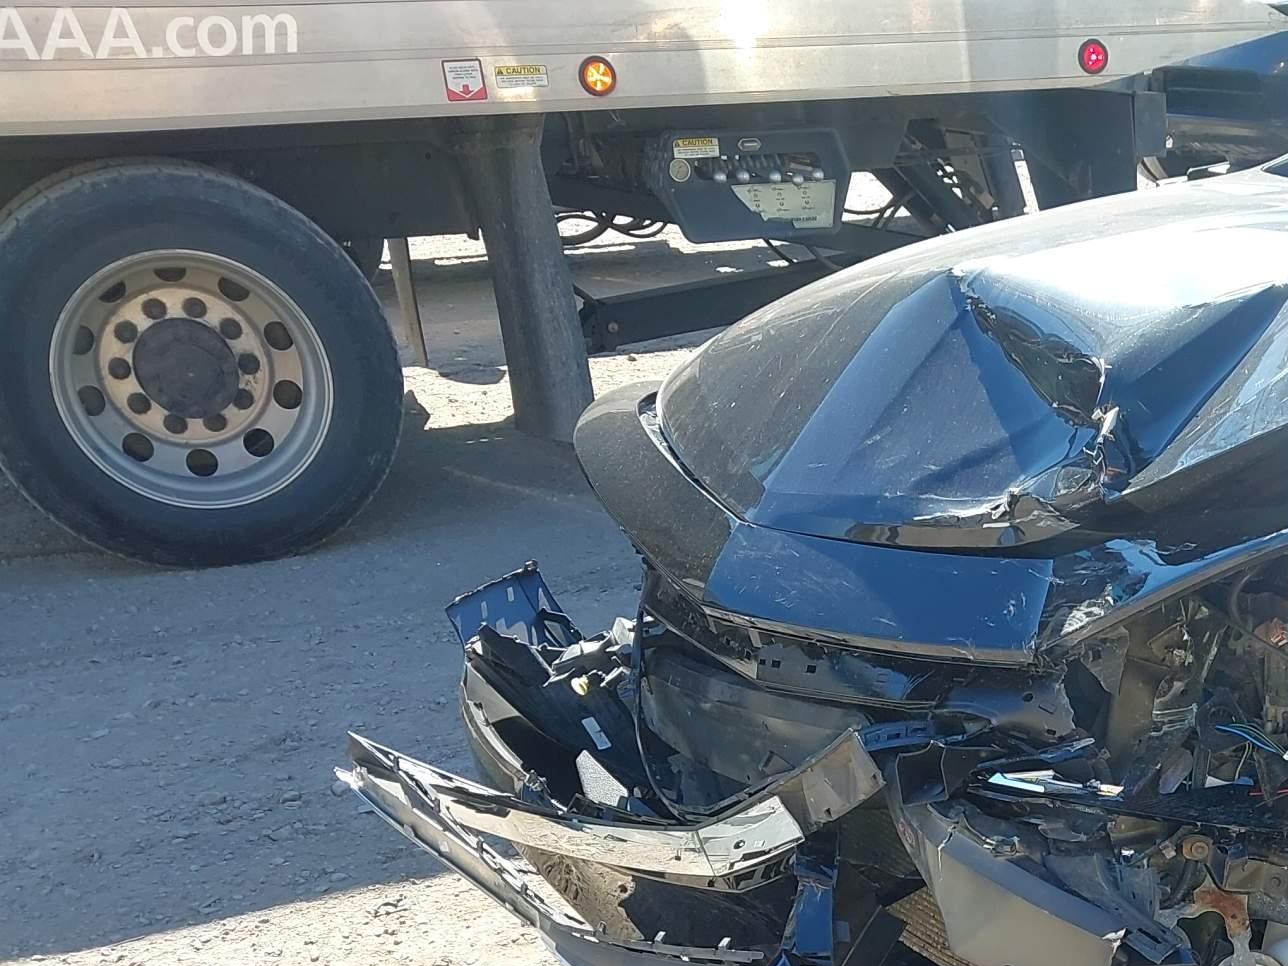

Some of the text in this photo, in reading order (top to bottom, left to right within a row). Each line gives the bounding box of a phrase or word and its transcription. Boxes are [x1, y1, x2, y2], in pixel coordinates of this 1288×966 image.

[0, 7, 298, 60] AAA.com
[505, 66, 541, 75] CAUTION
[682, 138, 713, 146] CAUTION
